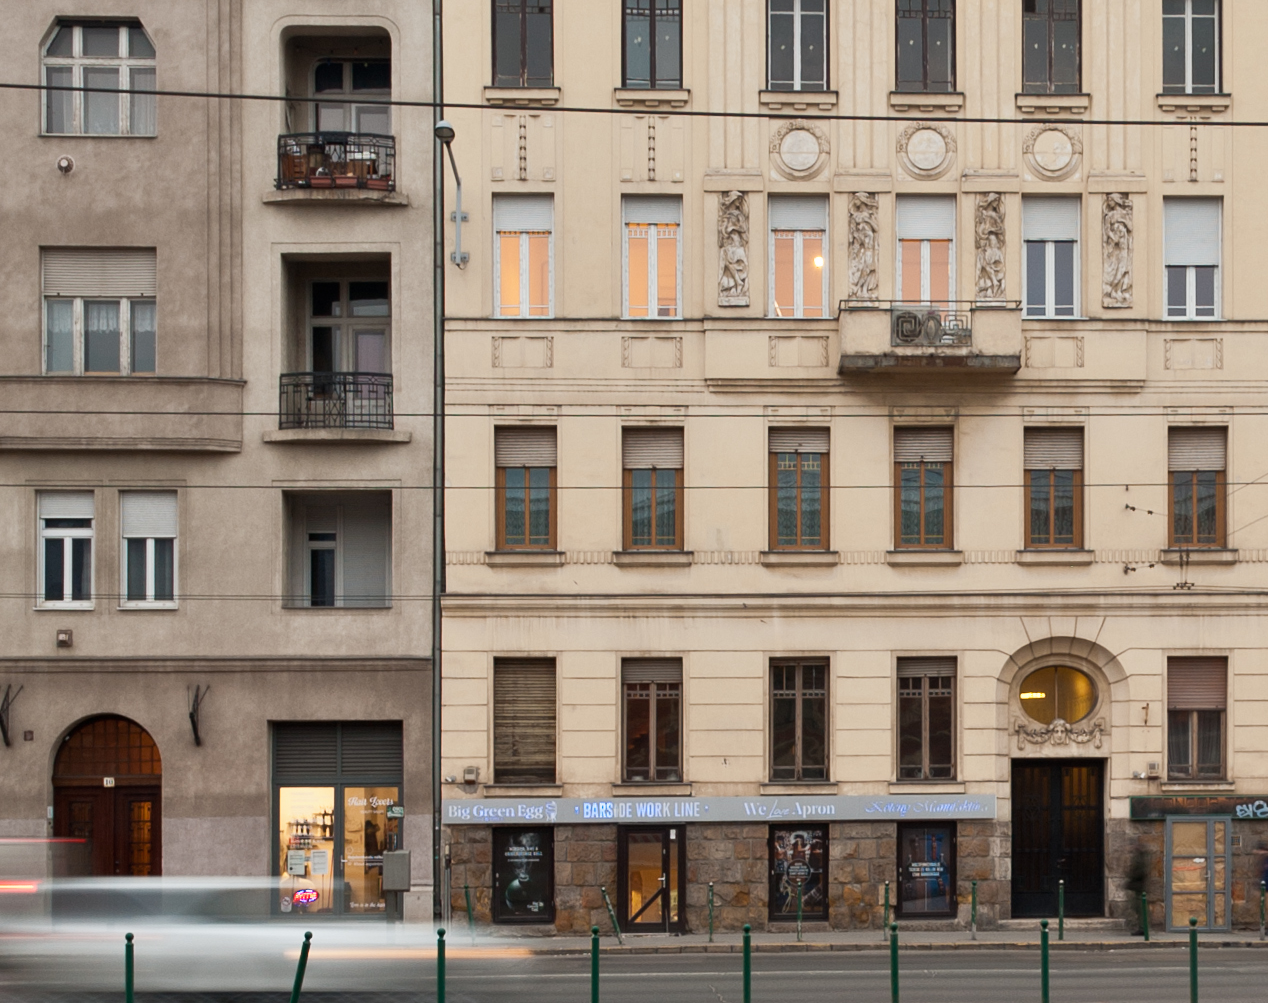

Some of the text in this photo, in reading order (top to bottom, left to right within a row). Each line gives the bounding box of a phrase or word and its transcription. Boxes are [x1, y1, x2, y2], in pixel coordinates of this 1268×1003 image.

[448, 804, 543, 820] Big Green Egg
[636, 802, 671, 817] WORK
[675, 802, 700, 817] LINE
[744, 802, 767, 816] We
[792, 802, 835, 818] Apron
